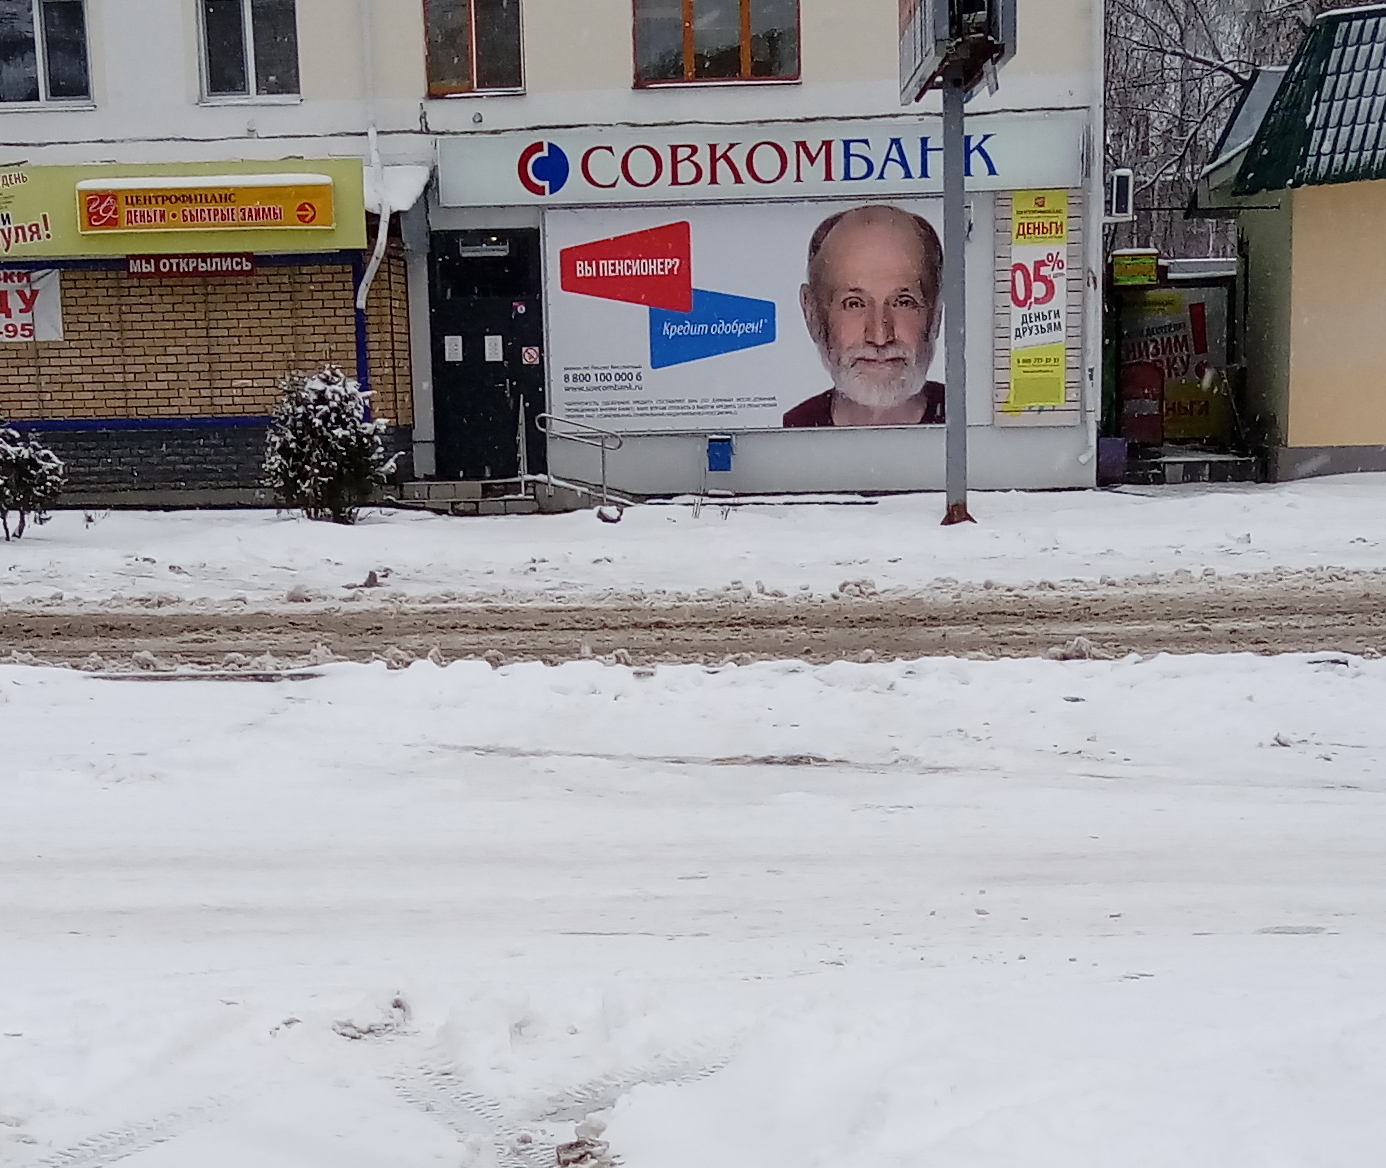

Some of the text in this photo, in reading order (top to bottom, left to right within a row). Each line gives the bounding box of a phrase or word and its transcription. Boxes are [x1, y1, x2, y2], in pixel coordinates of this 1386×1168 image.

[580, 133, 999, 190] СОВКОМБАНК
[2, 173, 28, 188] ДЕНЬ
[125, 193, 237, 206] ЦЕНТРОФИНАНС
[126, 205, 283, 225] ДЕНЬГИ БЫСТРЫЕ ЗАЙМЫ
[1016, 221, 1064, 239] ДЕНЬГИ
[129, 257, 253, 273] МЫ ОТКРЫЛИСЬ
[576, 258, 680, 277] ВЫ ПЕНСИОНЕР?
[1021, 309, 1061, 326] ДЕНЬГИ
[662, 321, 708, 340] Кредит
[1014, 321, 1062, 340] ДРУЗЬЯМ
[563, 371, 643, 383] 8 800 100 000 6
